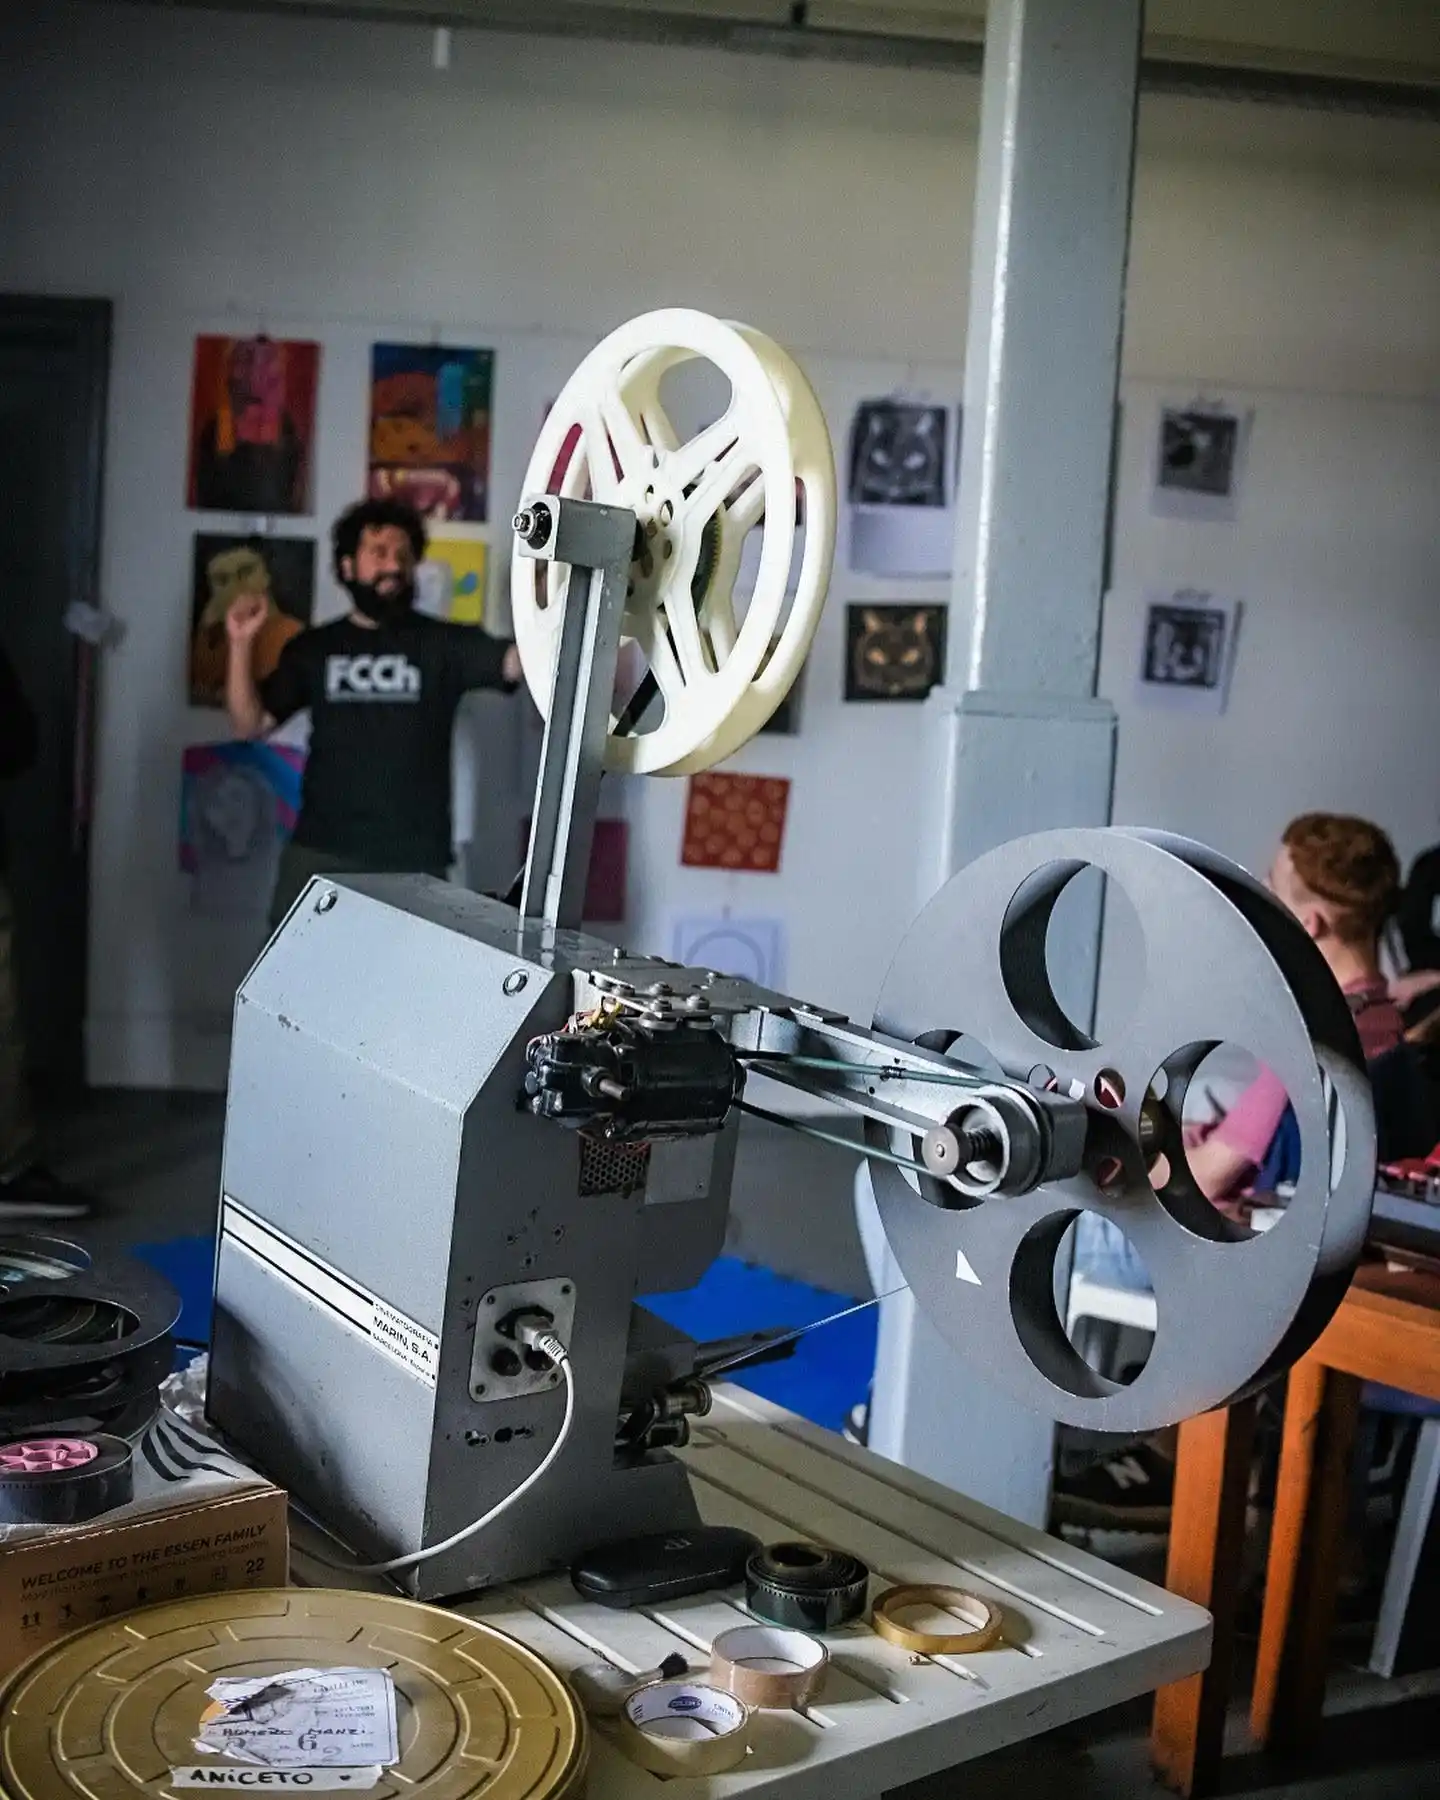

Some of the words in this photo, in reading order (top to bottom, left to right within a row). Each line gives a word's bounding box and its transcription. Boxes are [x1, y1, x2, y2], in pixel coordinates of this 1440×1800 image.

[325, 653, 422, 692] FCCh
[411, 1342, 432, 1364] S.A.
[21, 1561, 104, 1590] WELCOME
[108, 1557, 128, 1572] TO
[132, 1549, 161, 1567] THE
[163, 1537, 211, 1558] ESSEN
[213, 1523, 267, 1547] FAMILY
[245, 1558, 265, 1574] 22
